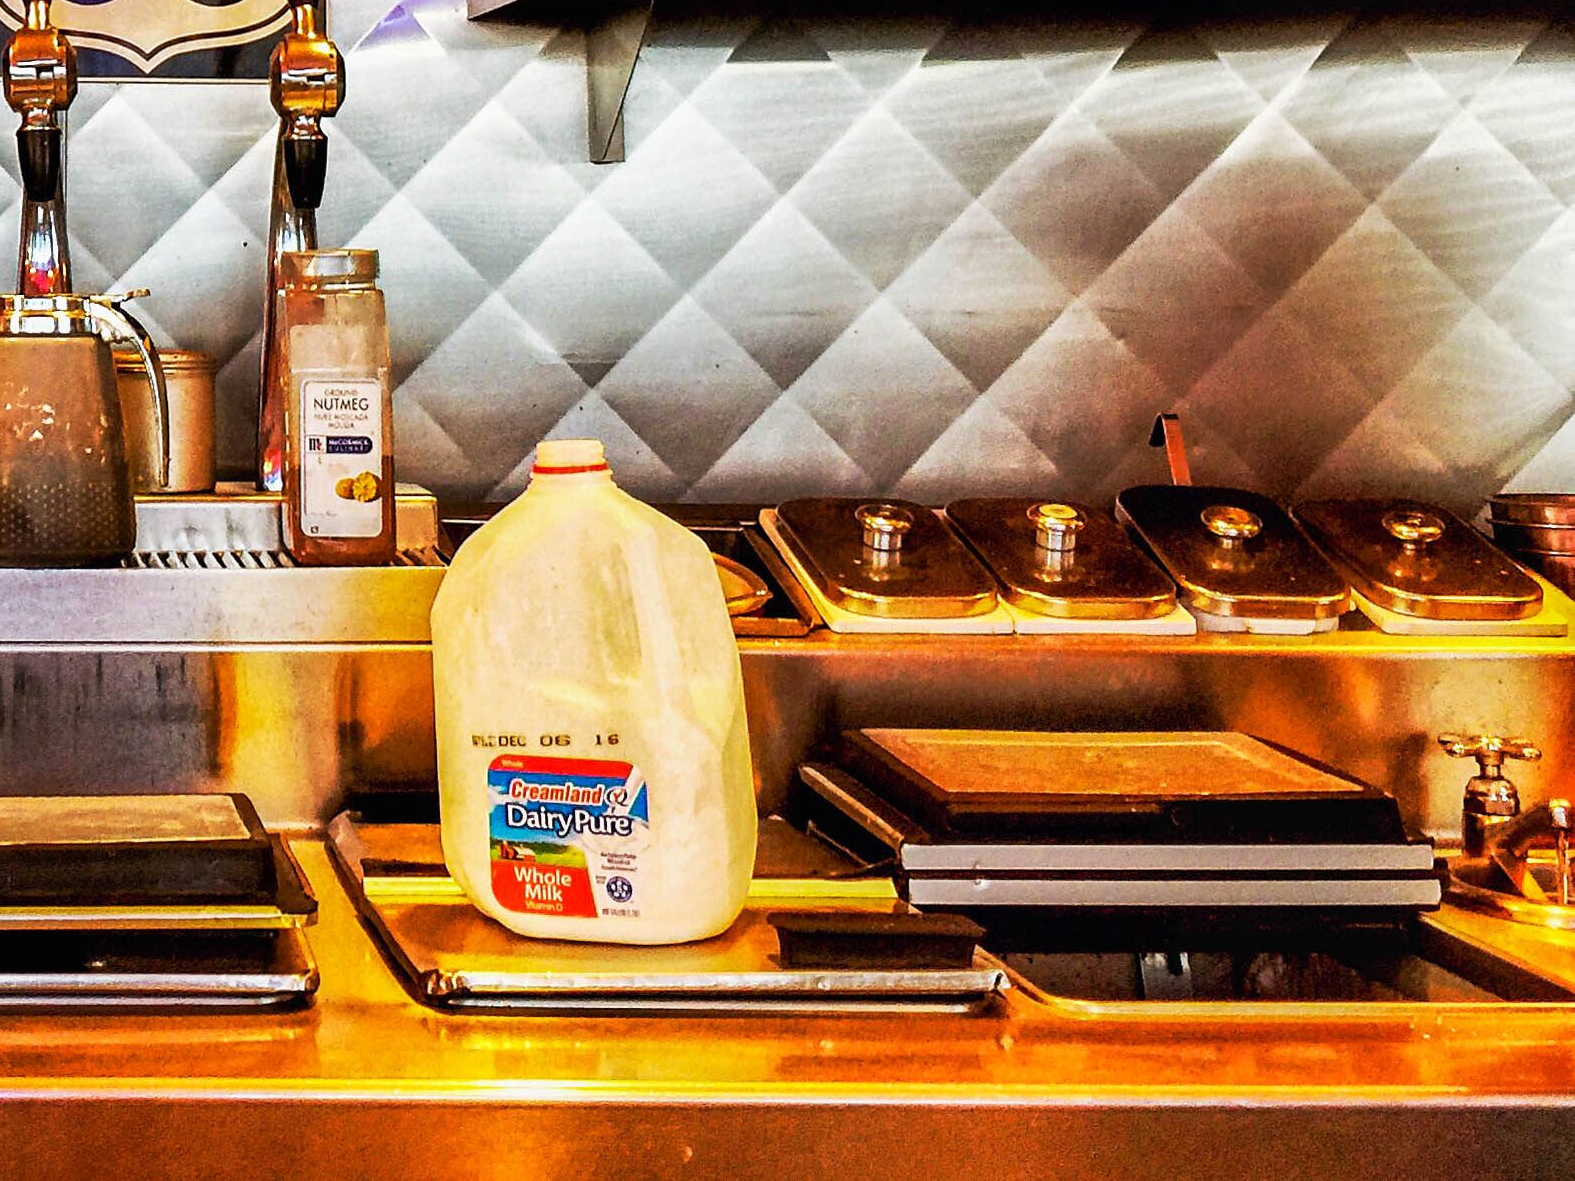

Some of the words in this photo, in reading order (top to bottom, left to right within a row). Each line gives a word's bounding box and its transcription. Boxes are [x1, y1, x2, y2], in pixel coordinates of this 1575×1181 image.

[324, 388, 358, 397] GROUND
[313, 397, 370, 411] NUTMEG
[498, 735, 527, 747] DEC
[539, 734, 571, 747] 06
[594, 733, 619, 746] 16
[510, 780, 603, 805] Creamland
[514, 866, 572, 887] Whole
[525, 884, 563, 902] Milk
